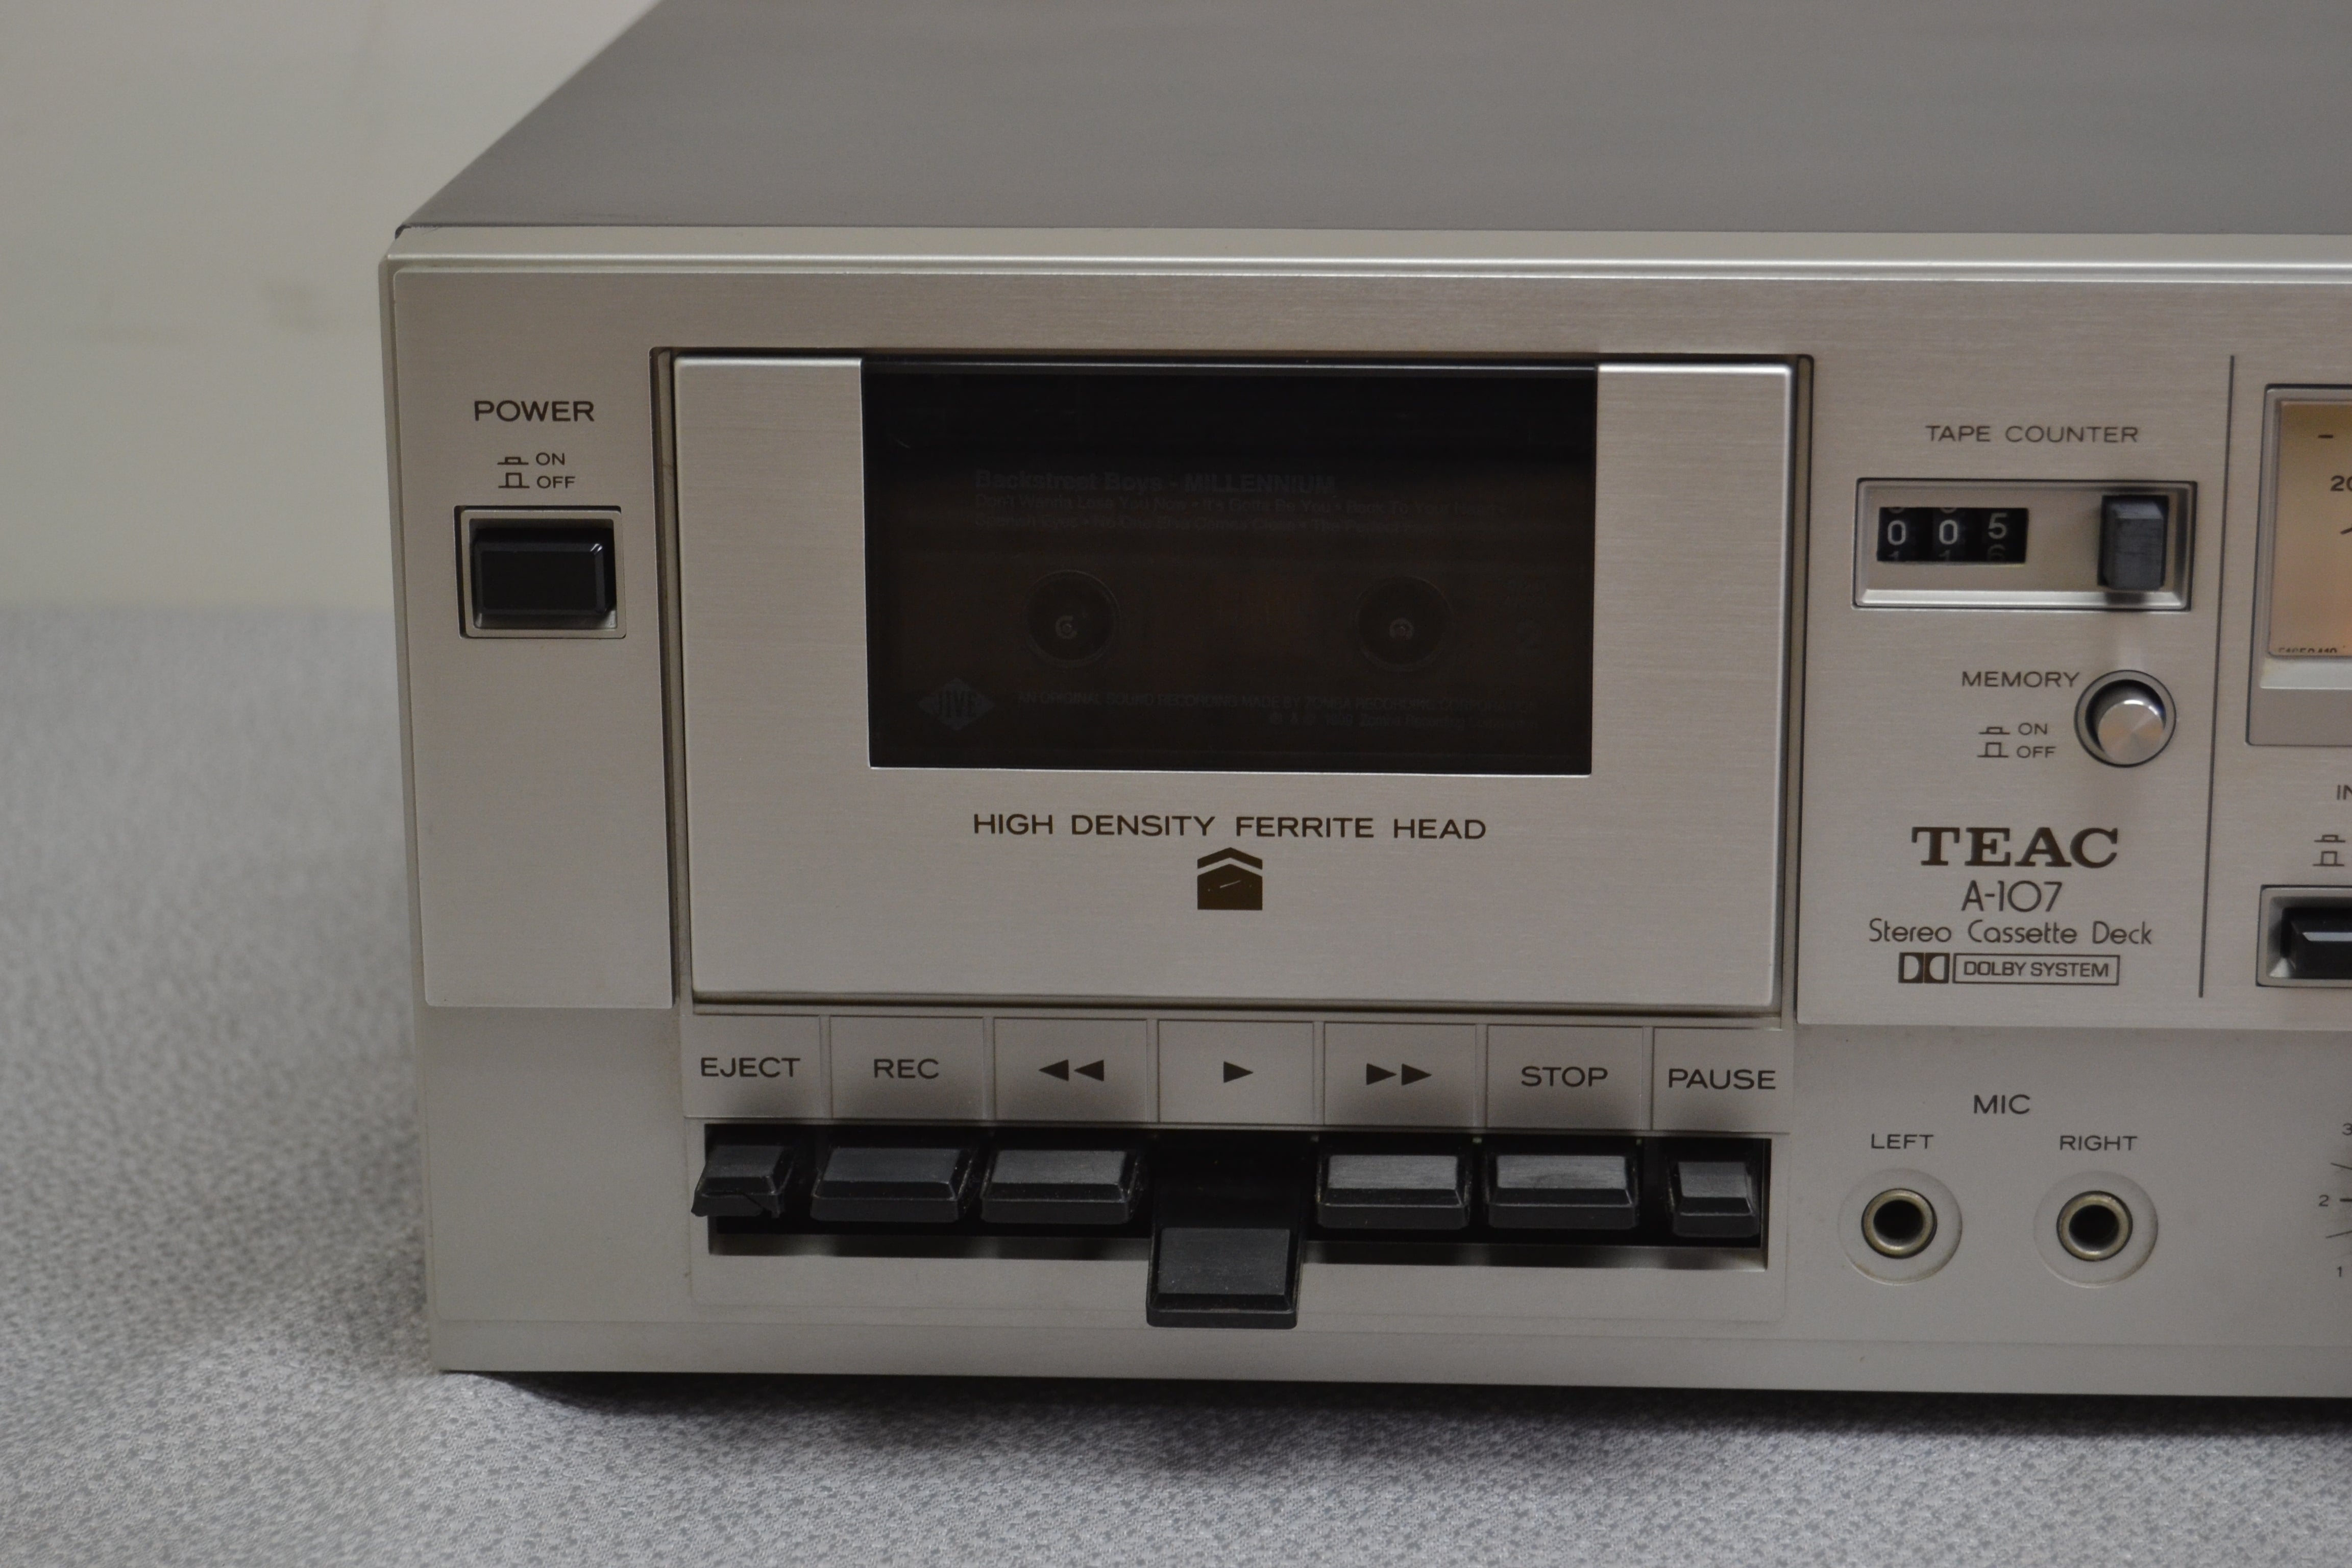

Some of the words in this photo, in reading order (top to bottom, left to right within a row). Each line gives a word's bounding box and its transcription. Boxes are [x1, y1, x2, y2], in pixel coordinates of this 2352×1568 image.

[474, 400, 594, 422] POWER
[1926, 426, 1990, 442] TAPE
[2005, 426, 2139, 443] COUNTER
[535, 452, 565, 465] ON
[536, 475, 575, 488] OFF
[975, 469, 1098, 491] Backstreet
[1104, 471, 1163, 496] Boys
[1184, 472, 1336, 494] MILLENNIUM
[1962, 671, 2080, 688] MEMORY
[2018, 722, 2048, 736] ON
[2017, 746, 2056, 758] OFF
[973, 814, 1054, 835] HIGH
[1071, 815, 1215, 837] DENSITY
[1236, 816, 1374, 839] FERRITE
[1393, 818, 1486, 840] HEAD
[1912, 826, 2118, 868] TEAC
[1961, 880, 2063, 913] A-107
[1869, 918, 1952, 943] Stereo
[1968, 919, 2077, 944] Cassette
[2093, 920, 2152, 944] Deck
[1964, 961, 2026, 976] DOLBY
[2030, 962, 2109, 977] SYSTEM
[700, 1057, 800, 1078] EJECT
[873, 1058, 939, 1080] REC
[1521, 1065, 1608, 1087] STOP
[1669, 1068, 1776, 1090] PAUSE
[1973, 1094, 2030, 1114] MIC
[1871, 1134, 1933, 1149] LEFT
[2060, 1135, 2138, 1151] RIGHT
[2318, 1194, 2330, 1207] 2
[2336, 1266, 2343, 1277] 1
